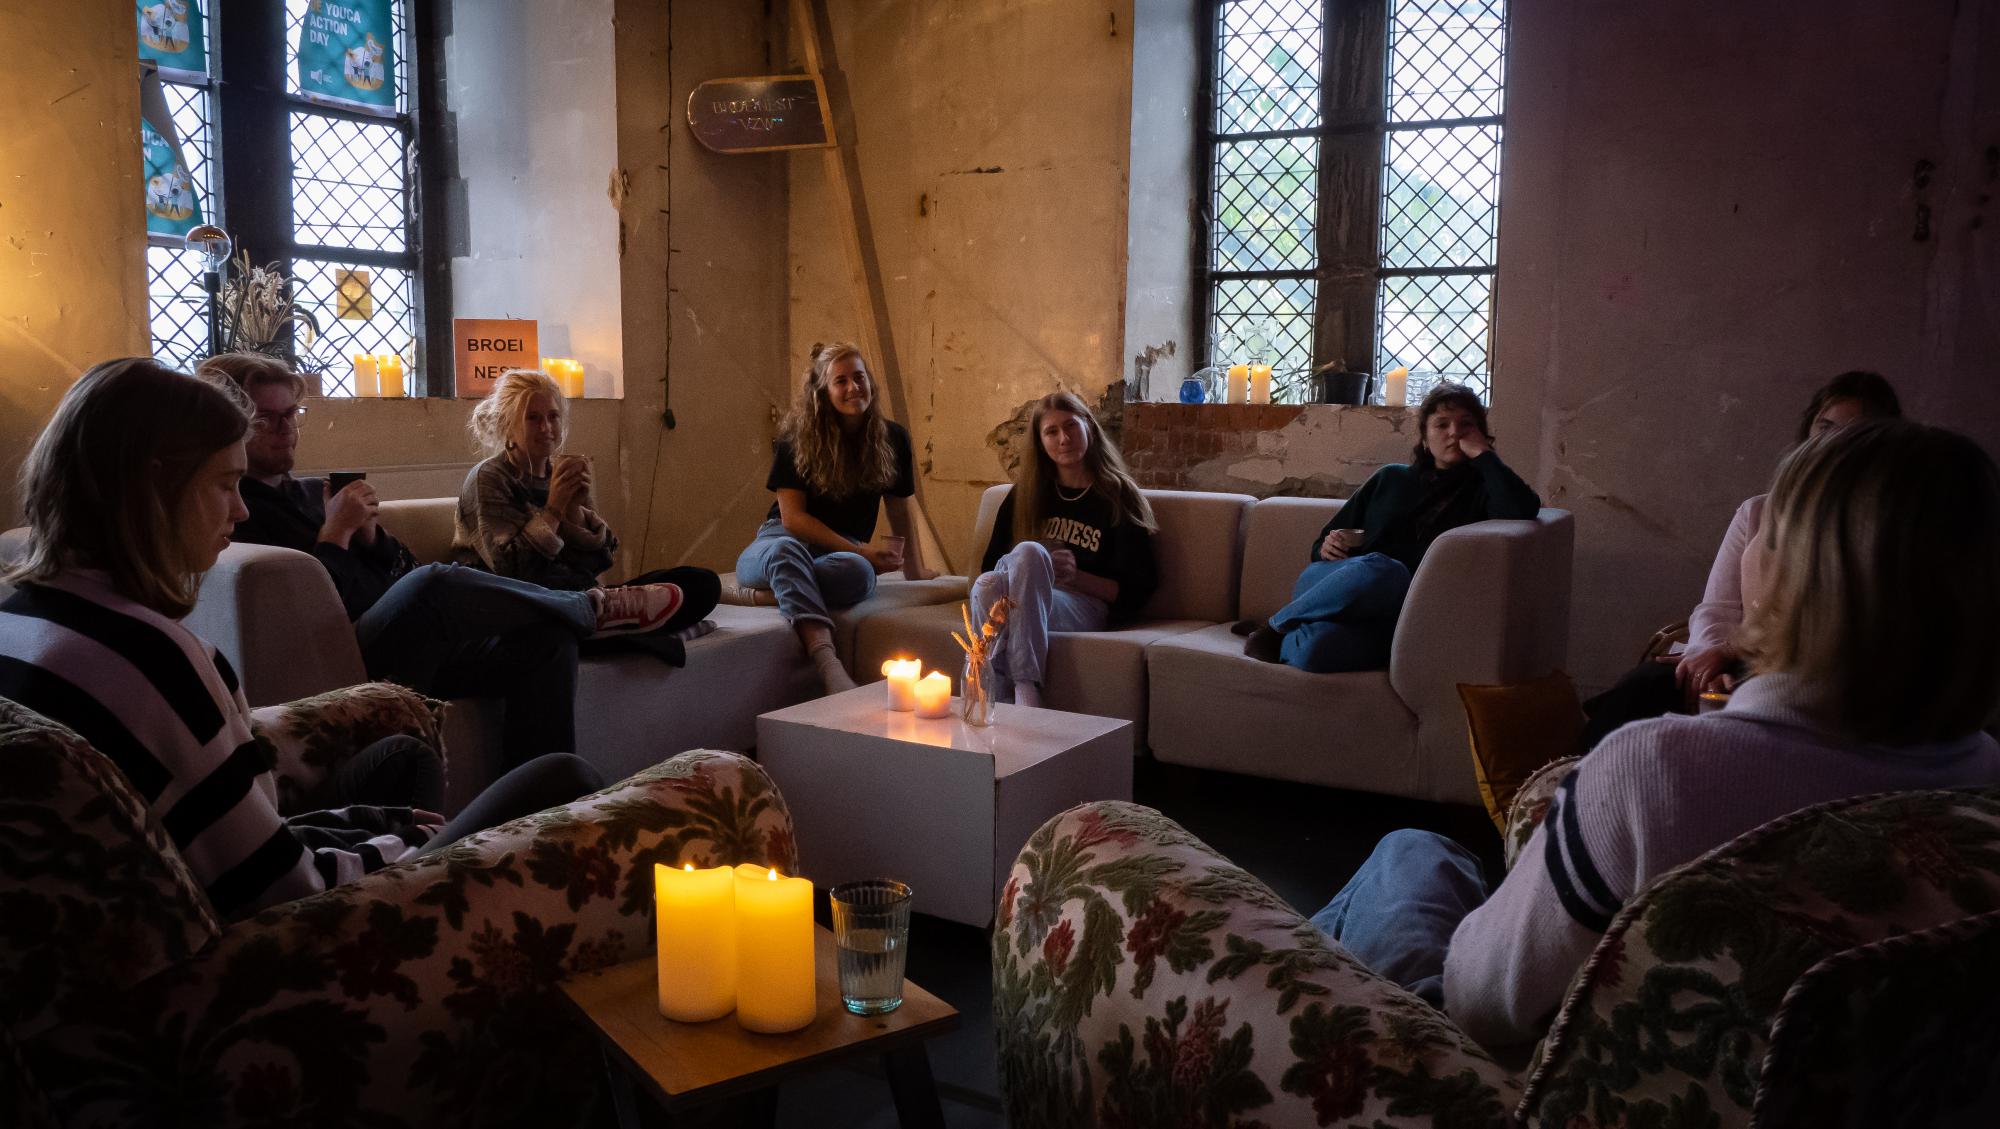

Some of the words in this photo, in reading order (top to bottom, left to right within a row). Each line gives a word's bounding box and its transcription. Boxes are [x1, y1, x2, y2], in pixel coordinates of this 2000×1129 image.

[325, 2, 361, 24] YOUCA
[309, 14, 348, 36] ACTION
[309, 30, 330, 47] DAY
[467, 338, 524, 352] BROEI
[474, 365, 521, 379] NE
